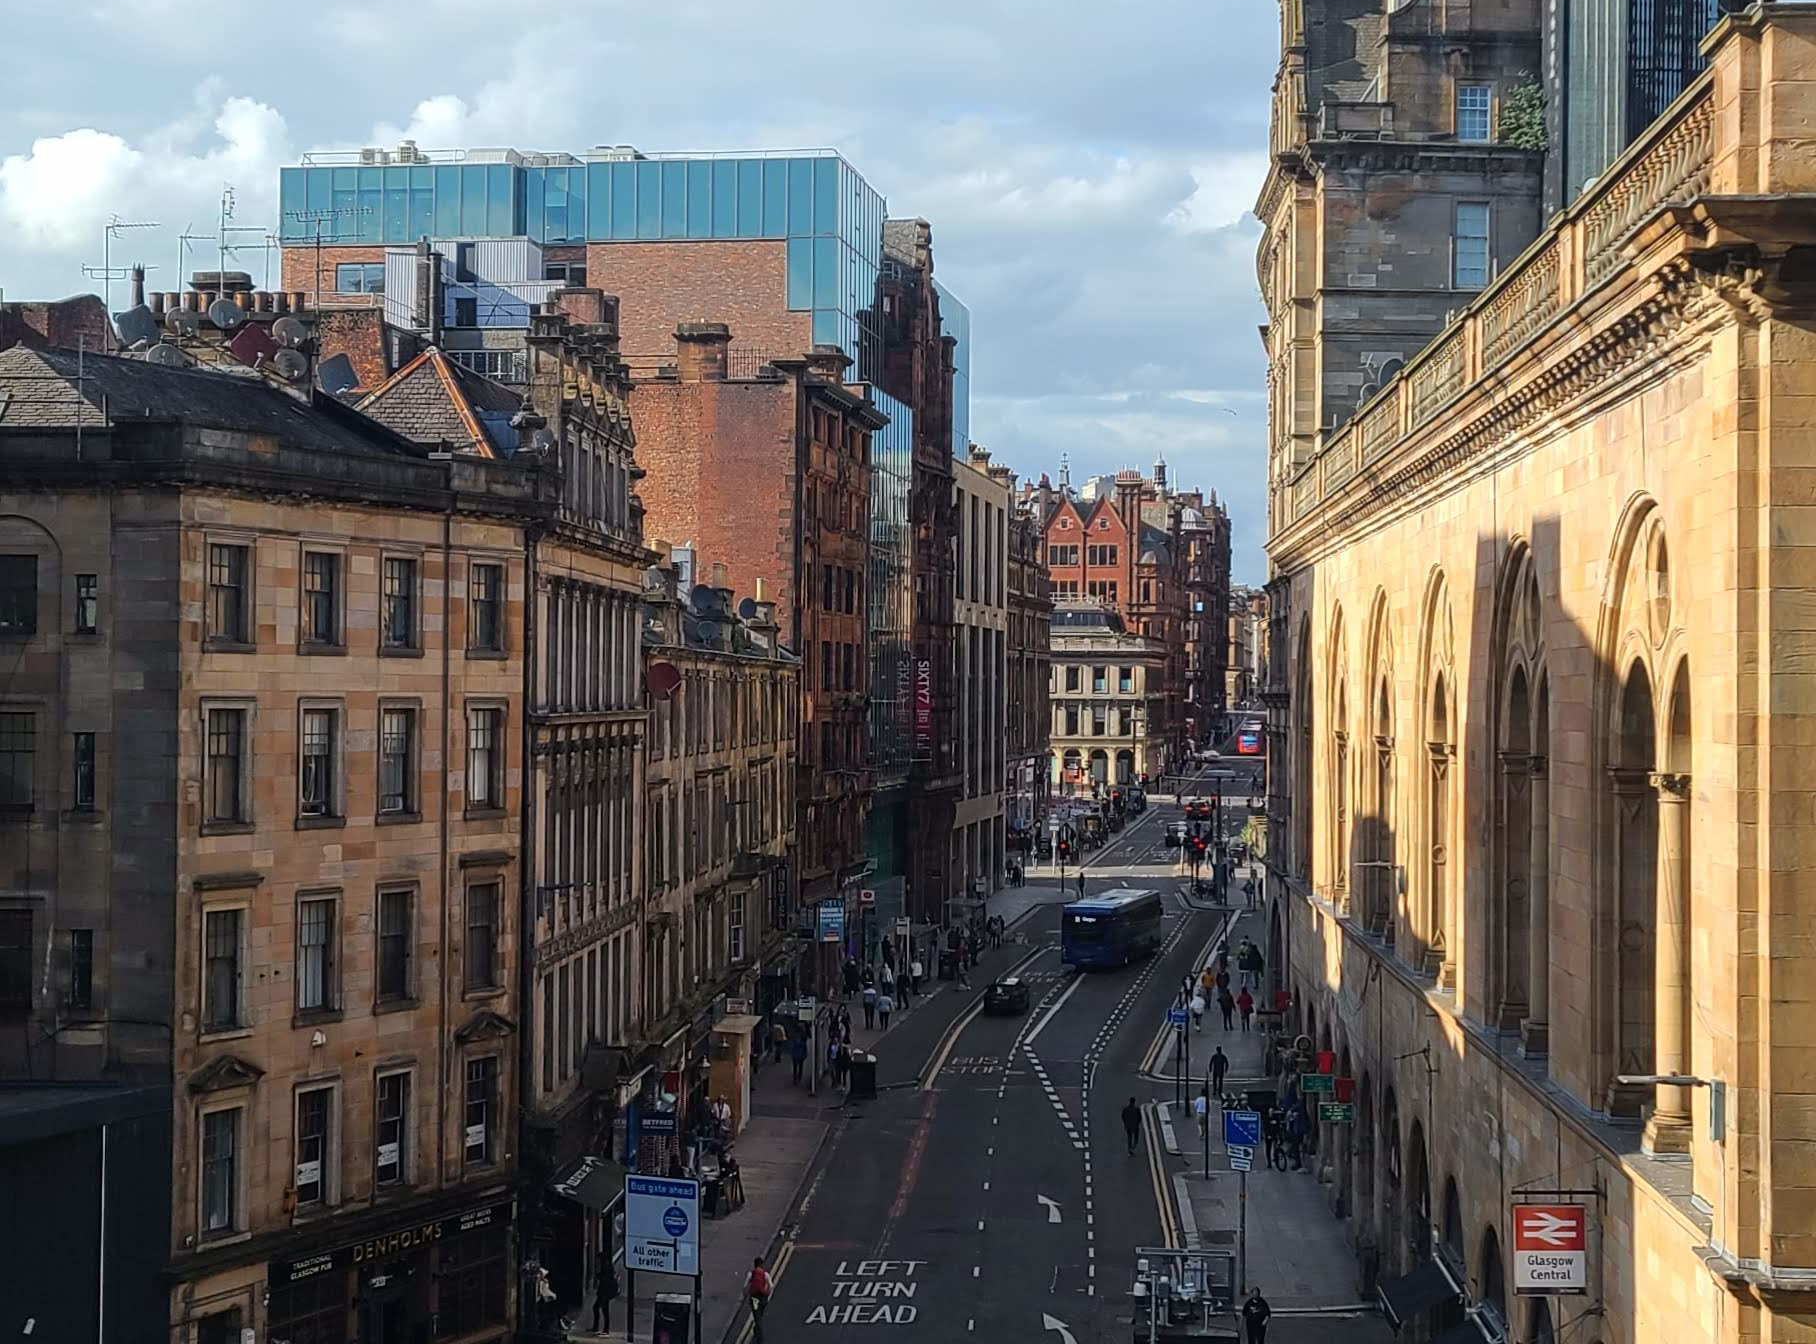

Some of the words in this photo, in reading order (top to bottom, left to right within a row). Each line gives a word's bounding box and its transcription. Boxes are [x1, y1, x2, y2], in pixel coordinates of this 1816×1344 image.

[631, 1181, 647, 1192] Bus
[648, 1184, 667, 1194] gate
[668, 1186, 694, 1196] ahead
[353, 1223, 442, 1262] DENHOLMS
[633, 1246, 645, 1255] All
[648, 1248, 669, 1257] other
[293, 1255, 332, 1271] TRADITIONAL
[638, 1257, 664, 1268] traffic
[836, 1261, 928, 1276] LEFT
[1528, 1255, 1574, 1268] Glasgow
[290, 1266, 320, 1281] GLASGOW
[320, 1262, 333, 1272] PUB
[1530, 1269, 1571, 1280] Central
[832, 1282, 917, 1297] TURN
[805, 1304, 917, 1323] AHEAD
